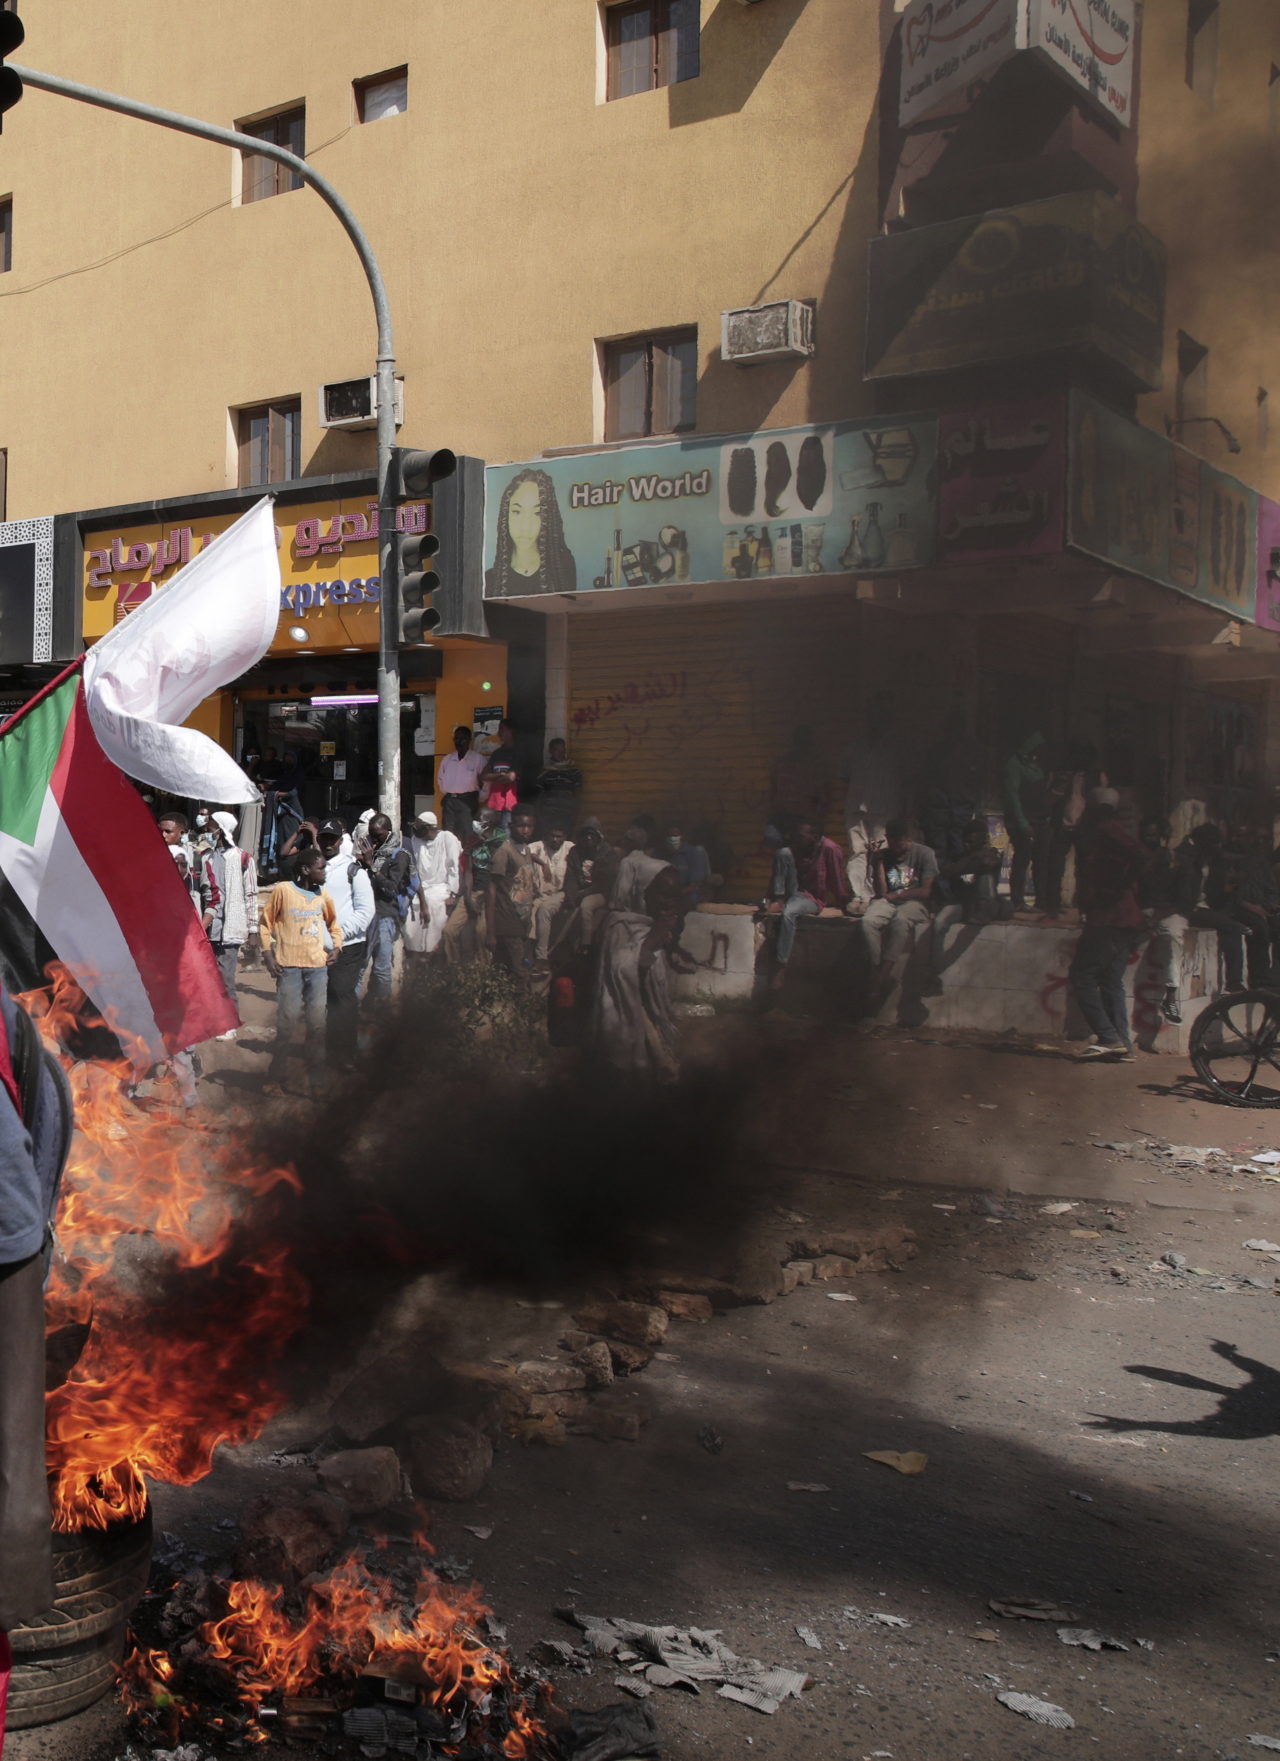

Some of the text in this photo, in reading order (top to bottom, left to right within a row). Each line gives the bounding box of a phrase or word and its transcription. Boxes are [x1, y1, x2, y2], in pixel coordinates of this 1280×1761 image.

[570, 469, 711, 510] Hair World
[280, 575, 381, 617] xpress
